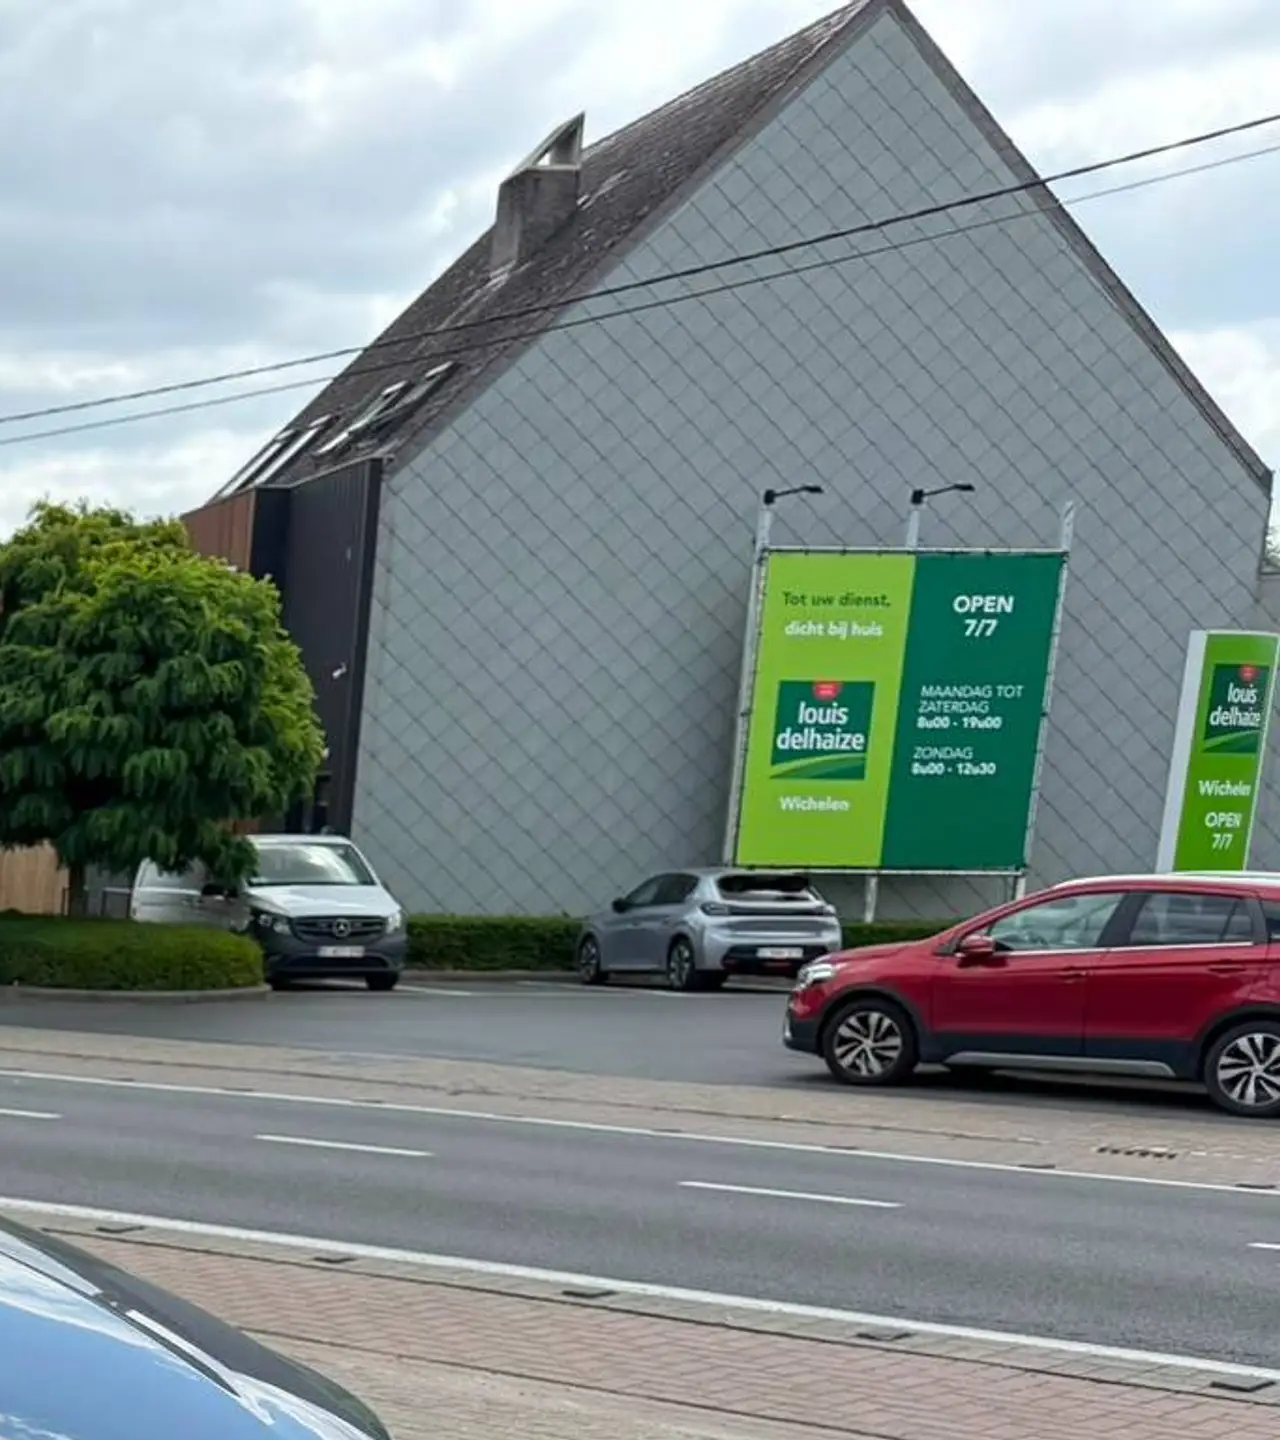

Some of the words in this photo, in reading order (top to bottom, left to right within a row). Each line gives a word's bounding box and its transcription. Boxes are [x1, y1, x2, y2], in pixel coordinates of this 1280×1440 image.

[783, 592, 806, 606] Tot
[811, 596, 834, 606] uw
[953, 595, 1014, 613] OPEN
[785, 621, 823, 636] dicht
[827, 621, 847, 640] bij
[851, 621, 883, 636] huis
[964, 619, 997, 637] 7/7
[920, 685, 992, 698] MAANDAG
[996, 685, 1024, 698] TOT
[1227, 682, 1257, 704] louis
[798, 701, 848, 725] louis
[918, 701, 989, 713] ZATERDAG
[1209, 706, 1261, 727] delhaize
[777, 728, 865, 750] delhaize
[913, 747, 973, 759] ZONDAG
[780, 797, 849, 811] Wichelen
[1204, 812, 1242, 828] OPEN
[1212, 834, 1234, 849] 7/7
